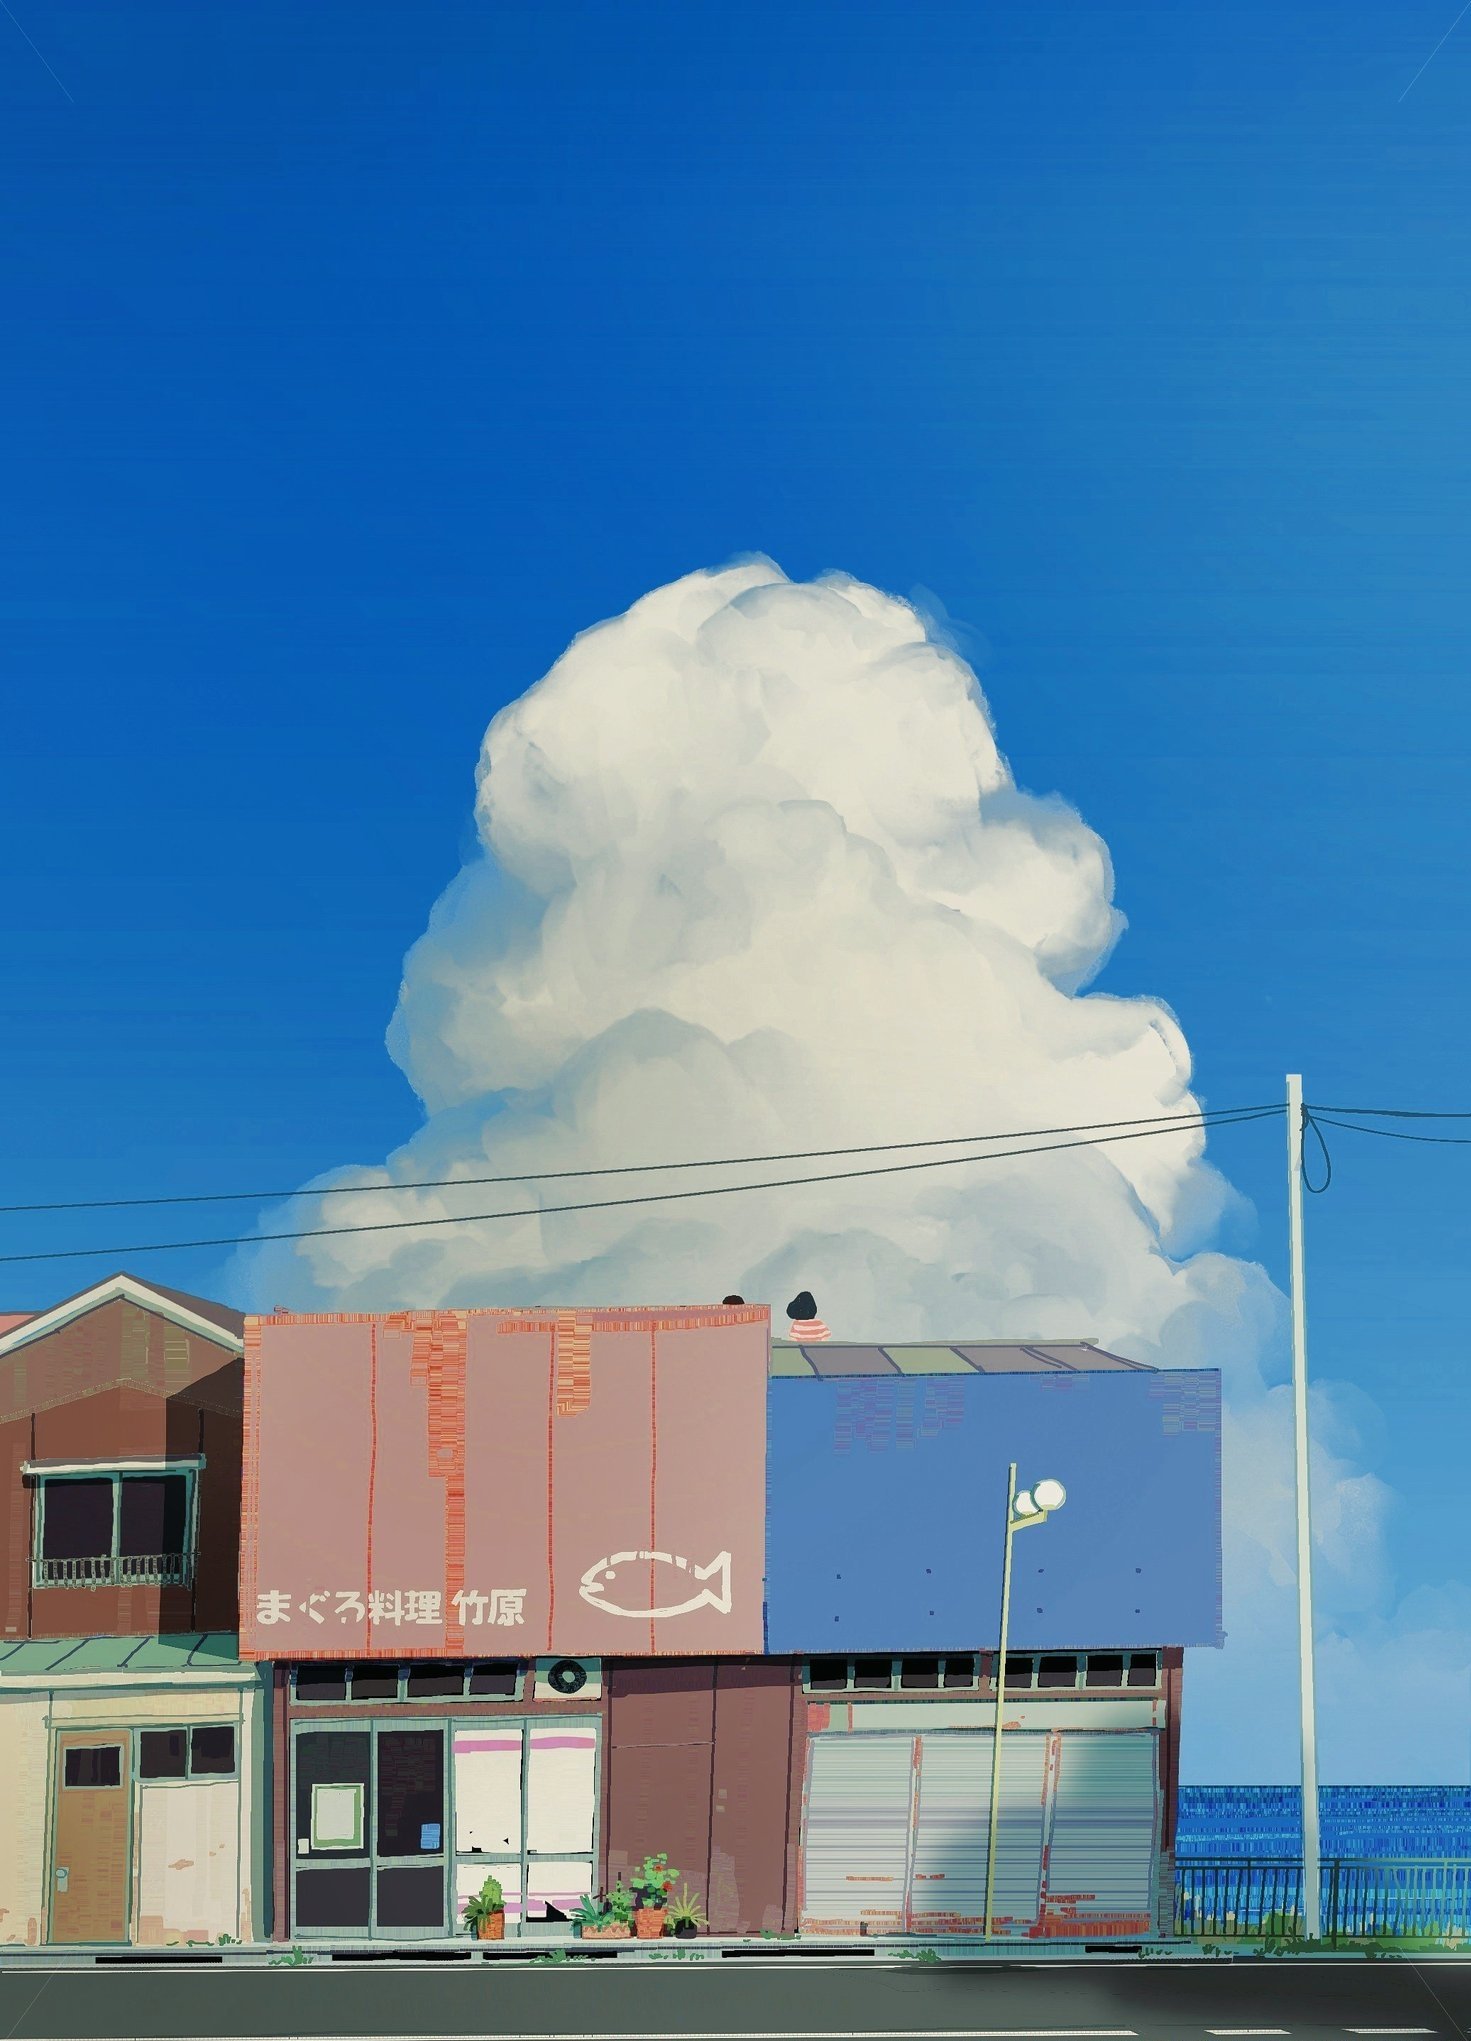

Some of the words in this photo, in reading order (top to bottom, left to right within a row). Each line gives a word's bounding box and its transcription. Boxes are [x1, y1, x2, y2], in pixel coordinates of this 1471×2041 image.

[257, 1589, 442, 1626] まぐろ料理
[451, 1588, 527, 1627] 竹原
